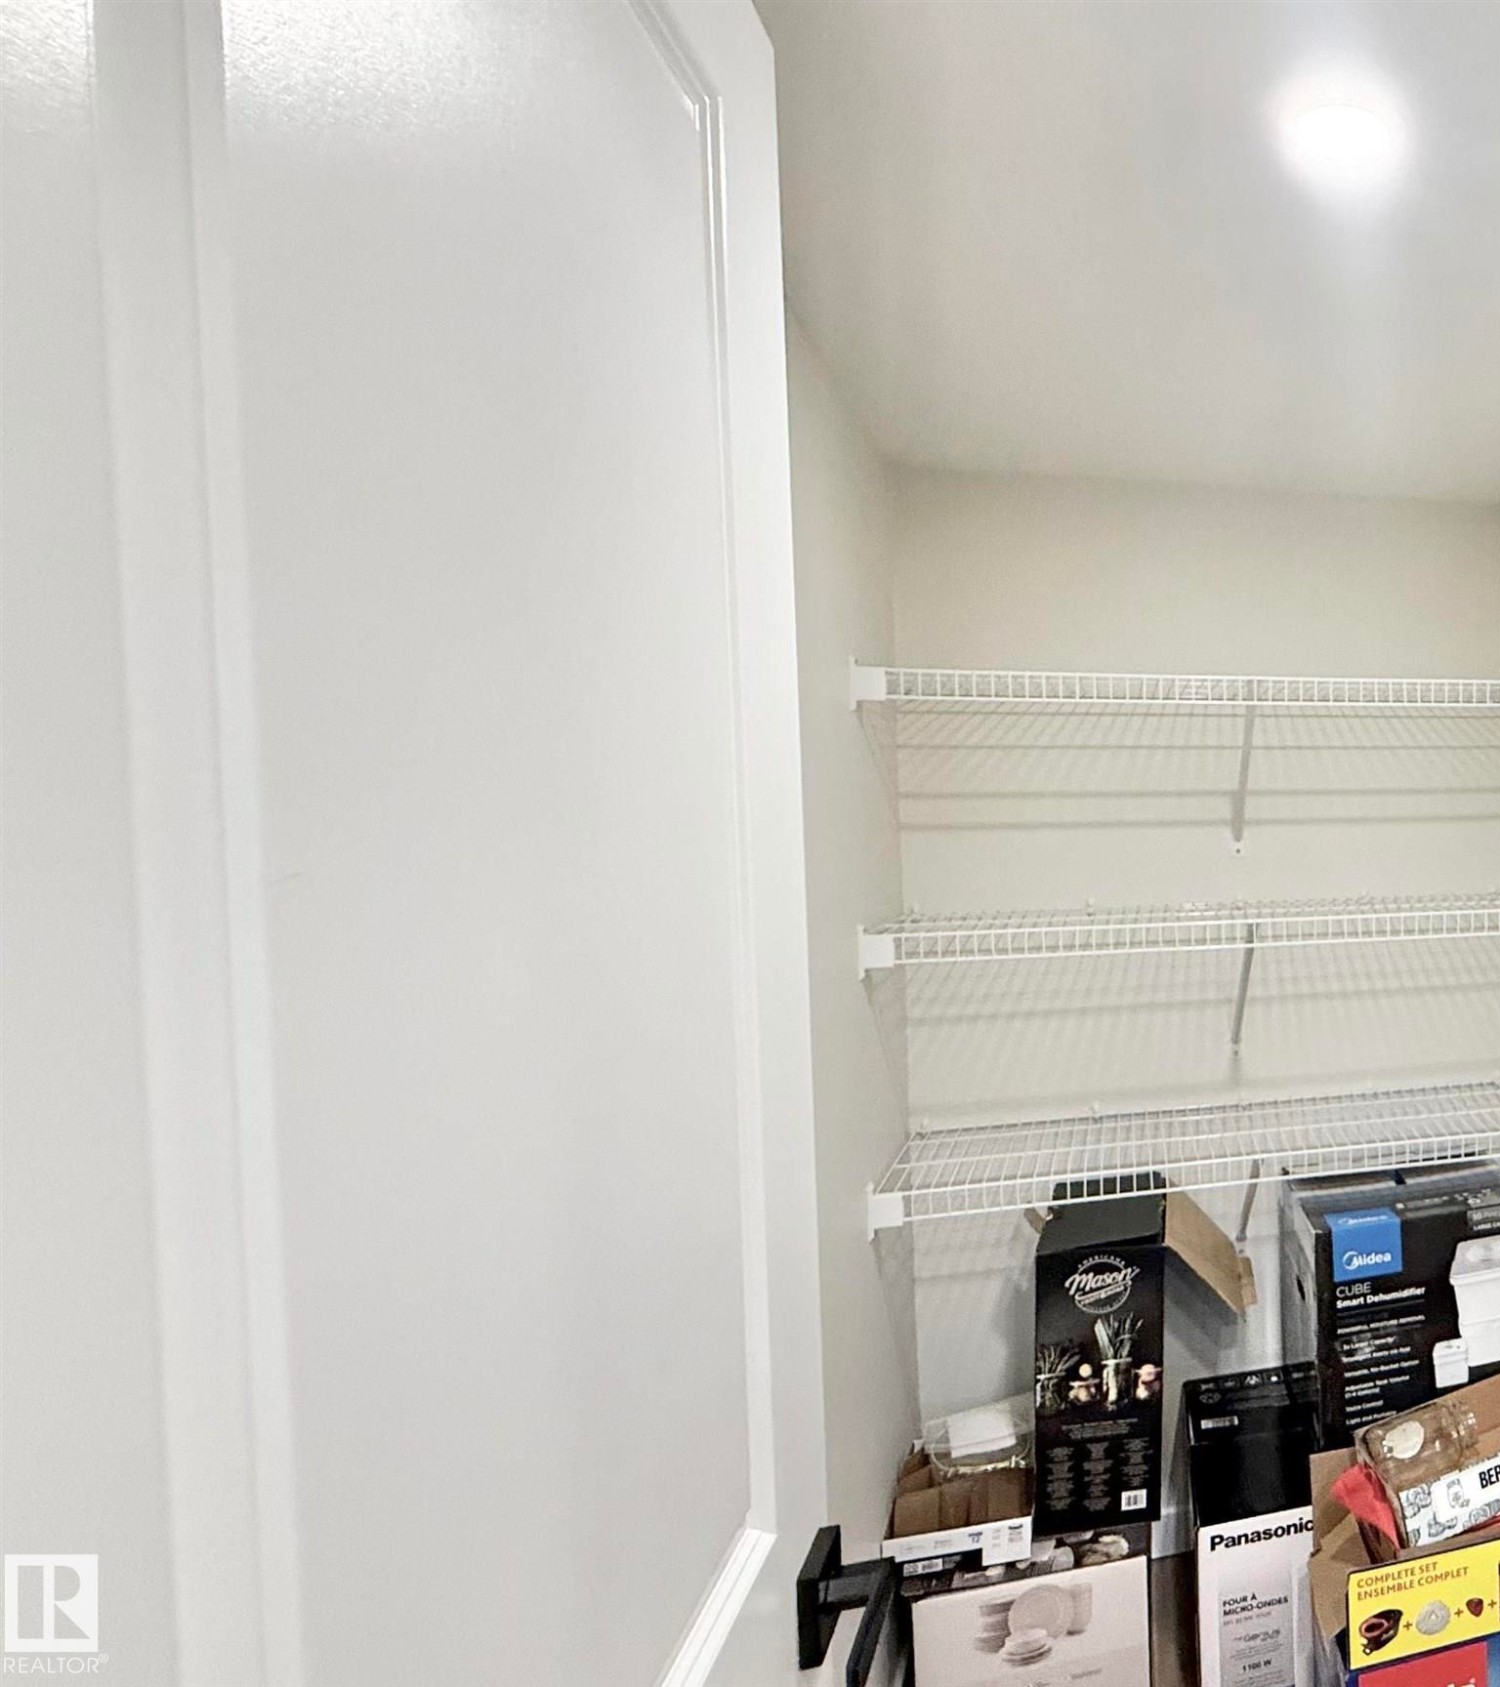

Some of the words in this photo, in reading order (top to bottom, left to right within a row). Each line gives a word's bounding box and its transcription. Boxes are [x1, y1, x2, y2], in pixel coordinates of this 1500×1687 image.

[1342, 1251, 1392, 1270] Midea
[1064, 1267, 1140, 1295] Mason
[1336, 1281, 1372, 1298] CUBE
[1336, 1296, 1365, 1309] Smart
[1366, 1286, 1426, 1304] Dehumidifier
[1210, 1518, 1313, 1551] Panasonic
[1357, 1567, 1417, 1589] COMPLETE
[1418, 1562, 1438, 1575] SET
[1357, 1579, 1415, 1601] ENSEMBLE
[1417, 1566, 1469, 1586] COMPLET
[1223, 1595, 1288, 1616] MICRO-ONDES
